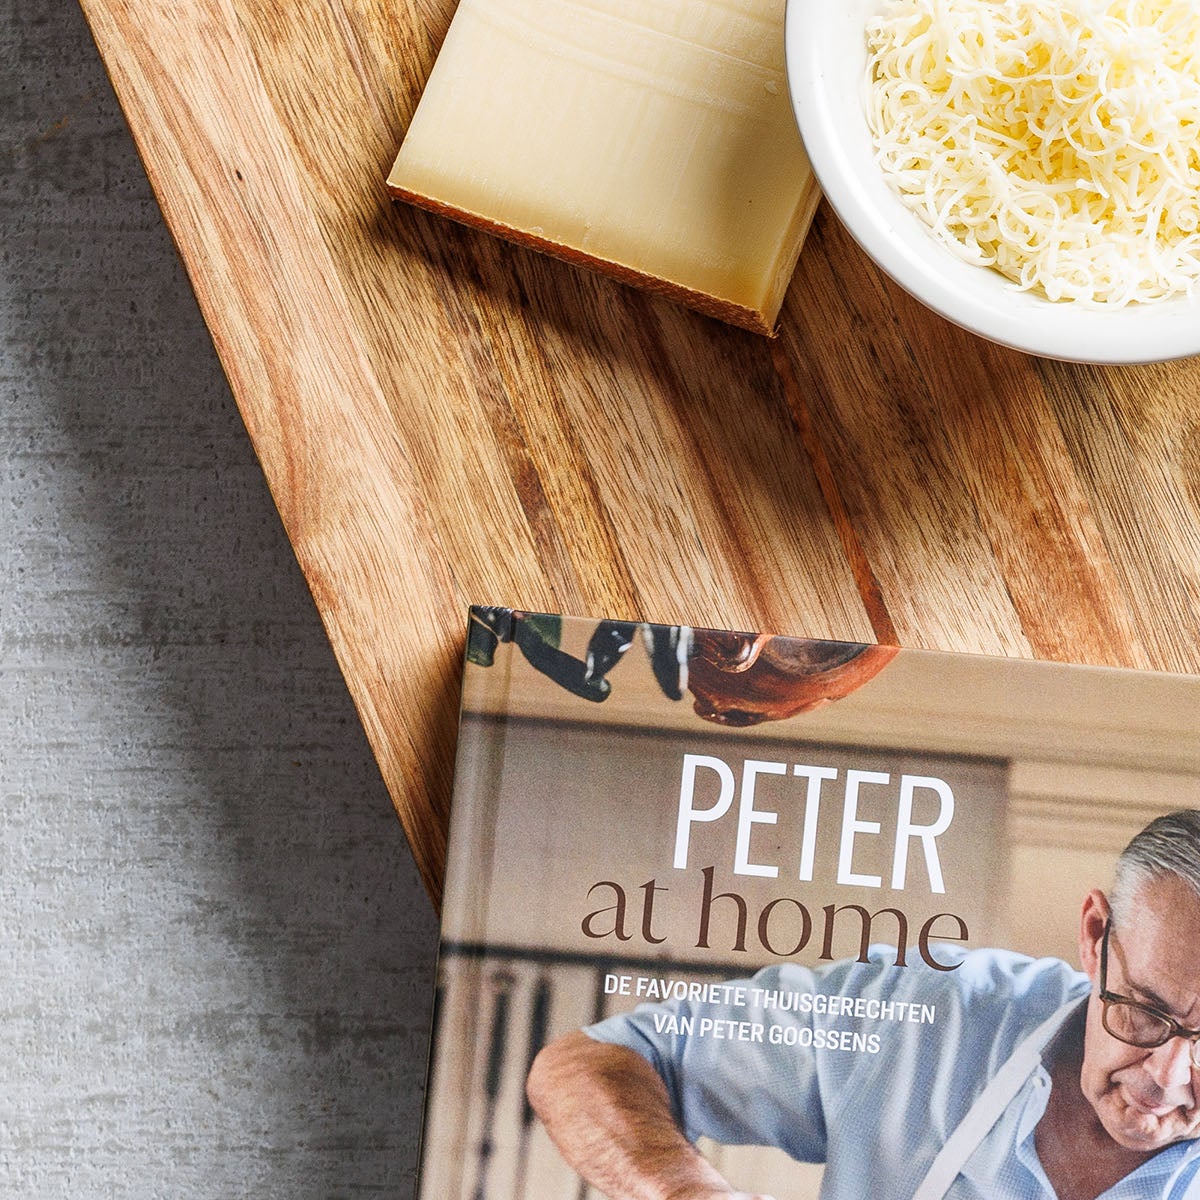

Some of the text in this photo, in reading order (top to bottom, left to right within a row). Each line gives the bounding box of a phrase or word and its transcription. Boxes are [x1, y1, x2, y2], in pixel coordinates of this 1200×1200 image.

[673, 753, 955, 894] PETER
[580, 866, 970, 972] at home
[603, 974, 936, 1025] DE FAVORIETE THUISGERECHTEN
[652, 1013, 881, 1055] VAN PETER GOOSSENS
